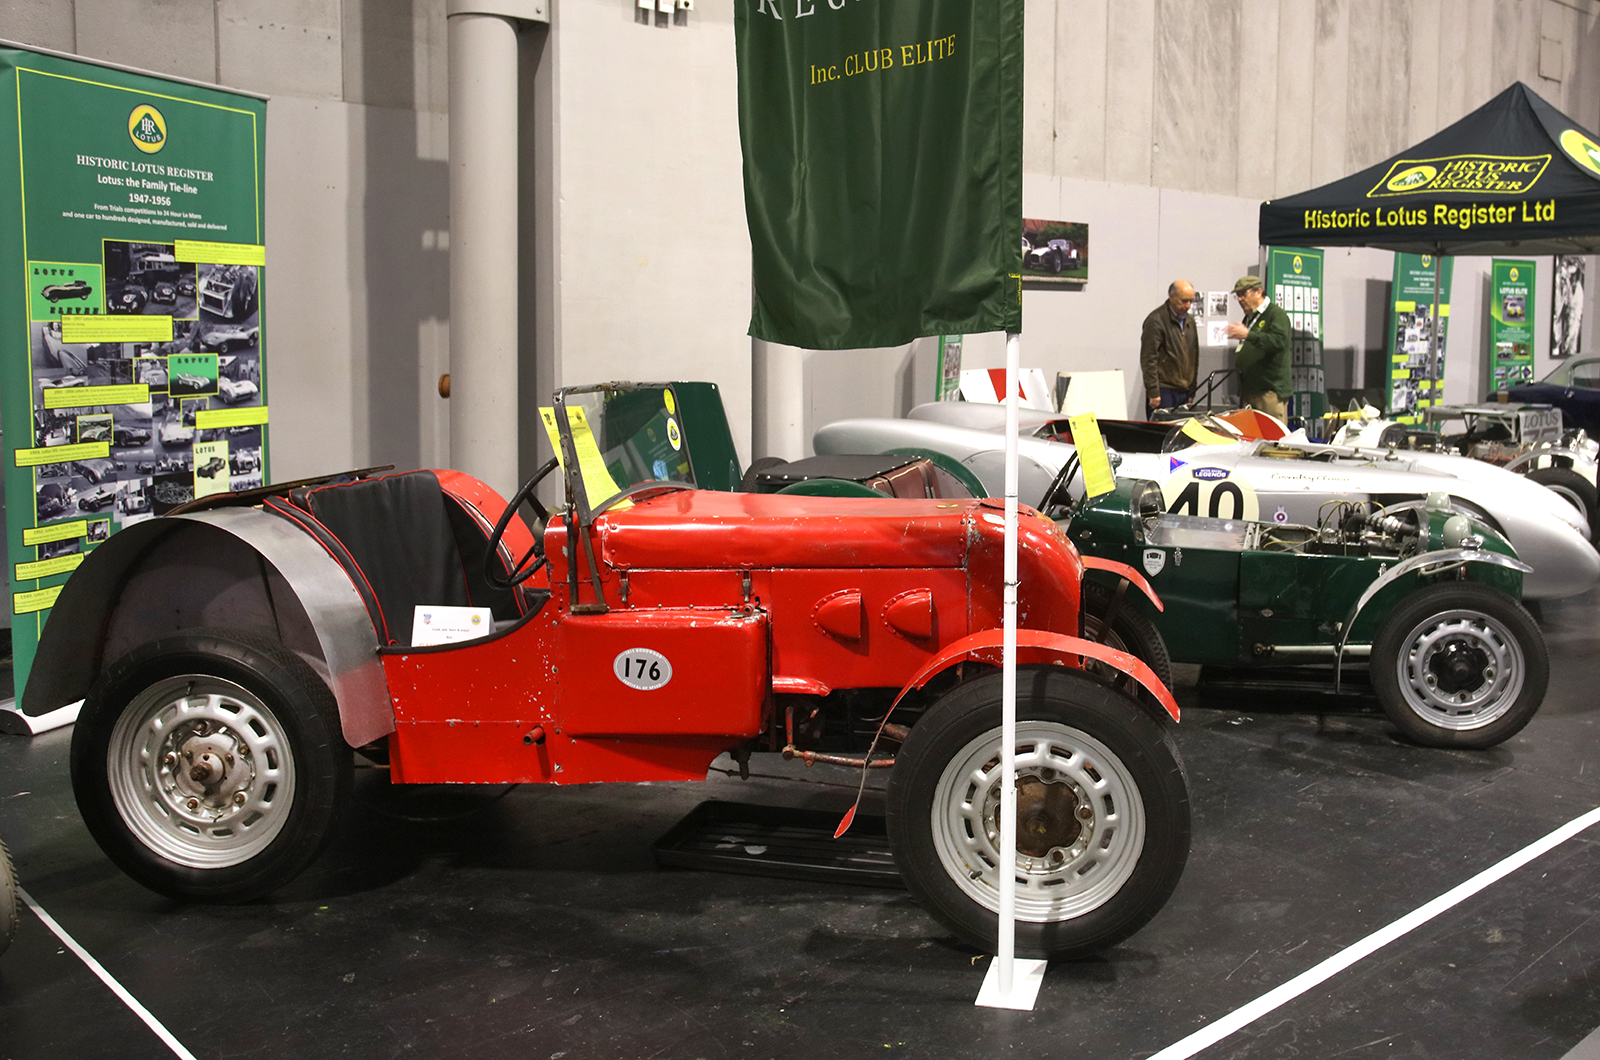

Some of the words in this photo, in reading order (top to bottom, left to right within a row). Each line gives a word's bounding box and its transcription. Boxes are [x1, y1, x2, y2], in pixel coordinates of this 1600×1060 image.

[810, 64, 841, 85] Inc.
[844, 48, 894, 77] CLUB
[900, 34, 956, 67] ELITE
[135, 130, 162, 142] LOTUS
[76, 154, 130, 171] HISTORIC
[132, 162, 165, 176] LOTUS
[167, 166, 214, 182] REGISTER
[1443, 160, 1540, 173] HISTORIC
[1436, 170, 1502, 181] LOTUS
[97, 174, 124, 186] Lotus:
[126, 177, 140, 188] the
[141, 179, 168, 193] Family
[169, 182, 198, 195] Tie-line
[1427, 180, 1522, 190] REGISTER
[128, 193, 172, 206] 1947-1956
[124, 207, 156, 215] competitions
[1304, 208, 1370, 229] Historic
[1376, 205, 1428, 226] Lotus
[1434, 202, 1516, 230] Register
[1522, 199, 1556, 222] Ltd
[102, 214, 126, 222] hundreds
[128, 216, 151, 225] designed,
[34, 268, 74, 276] LOTUS
[1524, 412, 1559, 429] LOTUS
[196, 446, 215, 454] LOTUS
[1166, 481, 1244, 520] 40
[625, 658, 660, 681] 176
[622, 679, 641, 690] FESTIVAL
